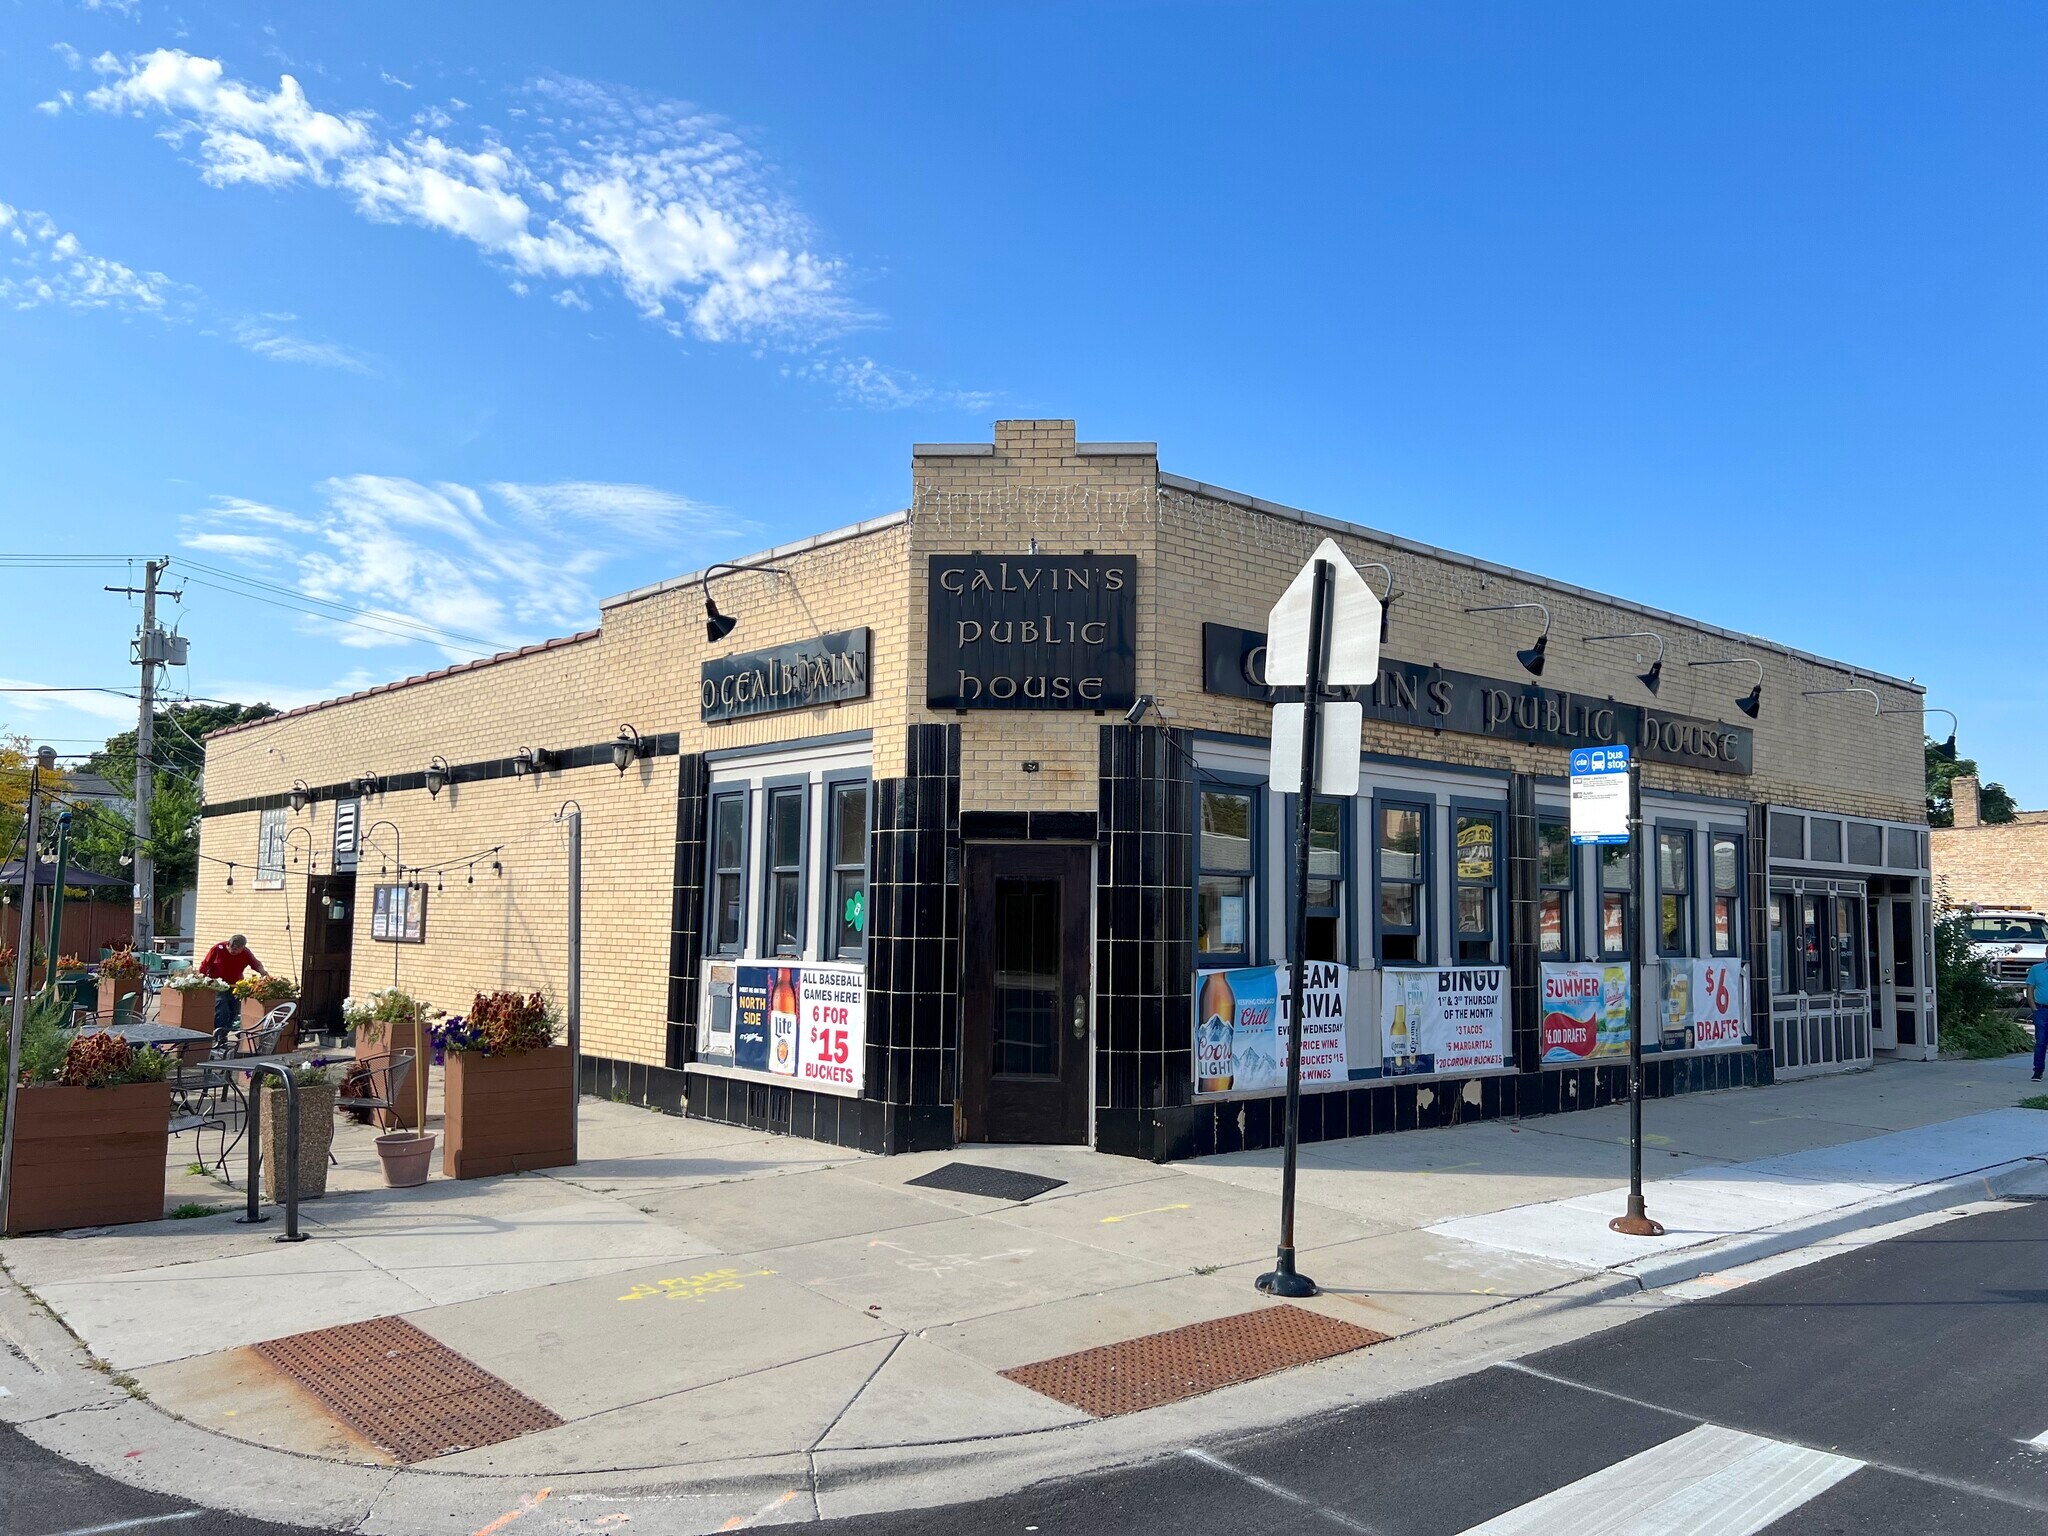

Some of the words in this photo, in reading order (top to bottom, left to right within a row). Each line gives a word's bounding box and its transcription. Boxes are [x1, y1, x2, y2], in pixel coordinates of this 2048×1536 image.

[940, 562, 1124, 596] GALVIN'S
[956, 615, 1107, 649] PUBLIC
[957, 669, 1104, 700] HOUSE
[1489, 689, 1614, 741] PUBLIC
[1642, 708, 1739, 762] HOUSE
[1607, 750, 1623, 760] bus
[1607, 760, 1627, 771] stop
[802, 973, 817, 984] ALL
[819, 974, 862, 988] BASEBALL
[1438, 970, 1500, 992] BINGO
[1546, 978, 1600, 998] SUMMER
[804, 988, 832, 1002] GAMES
[834, 990, 861, 1004] HERE!
[1705, 965, 1730, 1015] $6
[739, 996, 766, 1011] NORTH
[1447, 995, 1453, 1006] &
[1464, 995, 1499, 1006] THURSDAY
[743, 1011, 761, 1026] SIDE
[812, 1005, 820, 1022] 6
[823, 1006, 848, 1025] FOR
[1241, 1007, 1271, 1026] Chill
[1444, 1010, 1454, 1020] OF
[1455, 1009, 1468, 1019] THE
[1470, 1008, 1493, 1019] MONTH
[775, 1016, 792, 1038] Lite
[1302, 1023, 1344, 1034] WEDNESDAY
[1463, 1025, 1483, 1035] TACOS
[1696, 1019, 1739, 1041] DRAFTS
[1321, 1039, 1338, 1049] WINE
[1545, 1029, 1561, 1044] $6.00
[1562, 1028, 1587, 1043] DRAFTS
[810, 1025, 849, 1064] $15
[1197, 1036, 1232, 1061] Coors
[1453, 1040, 1493, 1051] MARGARITAS
[1200, 1061, 1231, 1075] LIGHT
[1280, 1057, 1284, 1067] 6
[1301, 1054, 1333, 1066] BUCKETS
[1333, 1053, 1344, 1063] $15
[1436, 1058, 1446, 1068] $20
[1446, 1056, 1473, 1067] CORONA
[1474, 1055, 1503, 1065] BUCKETS
[805, 1062, 854, 1083] BUCKETS
[1307, 1069, 1331, 1080] WINGS
